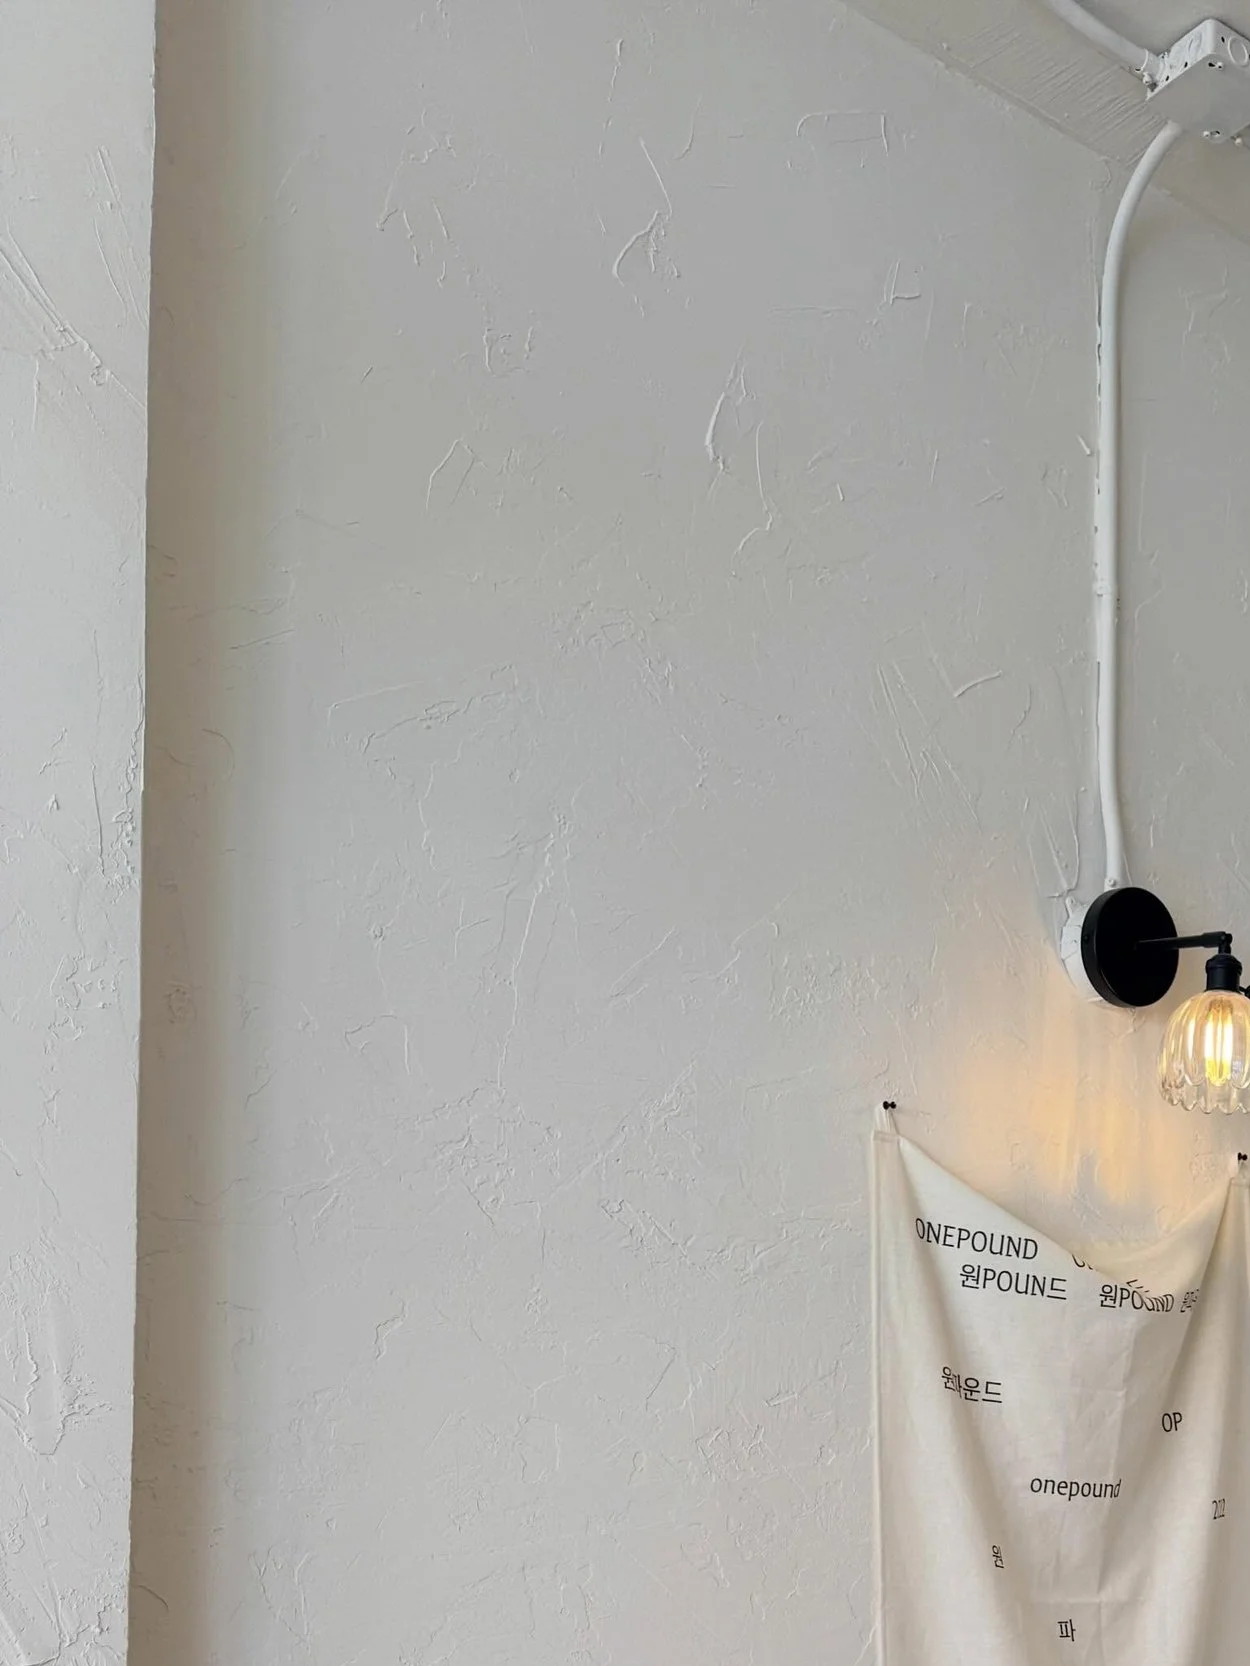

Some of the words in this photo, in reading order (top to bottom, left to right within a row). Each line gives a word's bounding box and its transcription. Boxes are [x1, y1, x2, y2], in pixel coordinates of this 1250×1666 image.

[915, 1217, 1039, 1260] ONEPOUND
[960, 1264, 1067, 1300] 원POUN드
[1161, 1412, 1183, 1433] OP
[1030, 1476, 1122, 1501] onepound
[1057, 1618, 1076, 1642] 파
